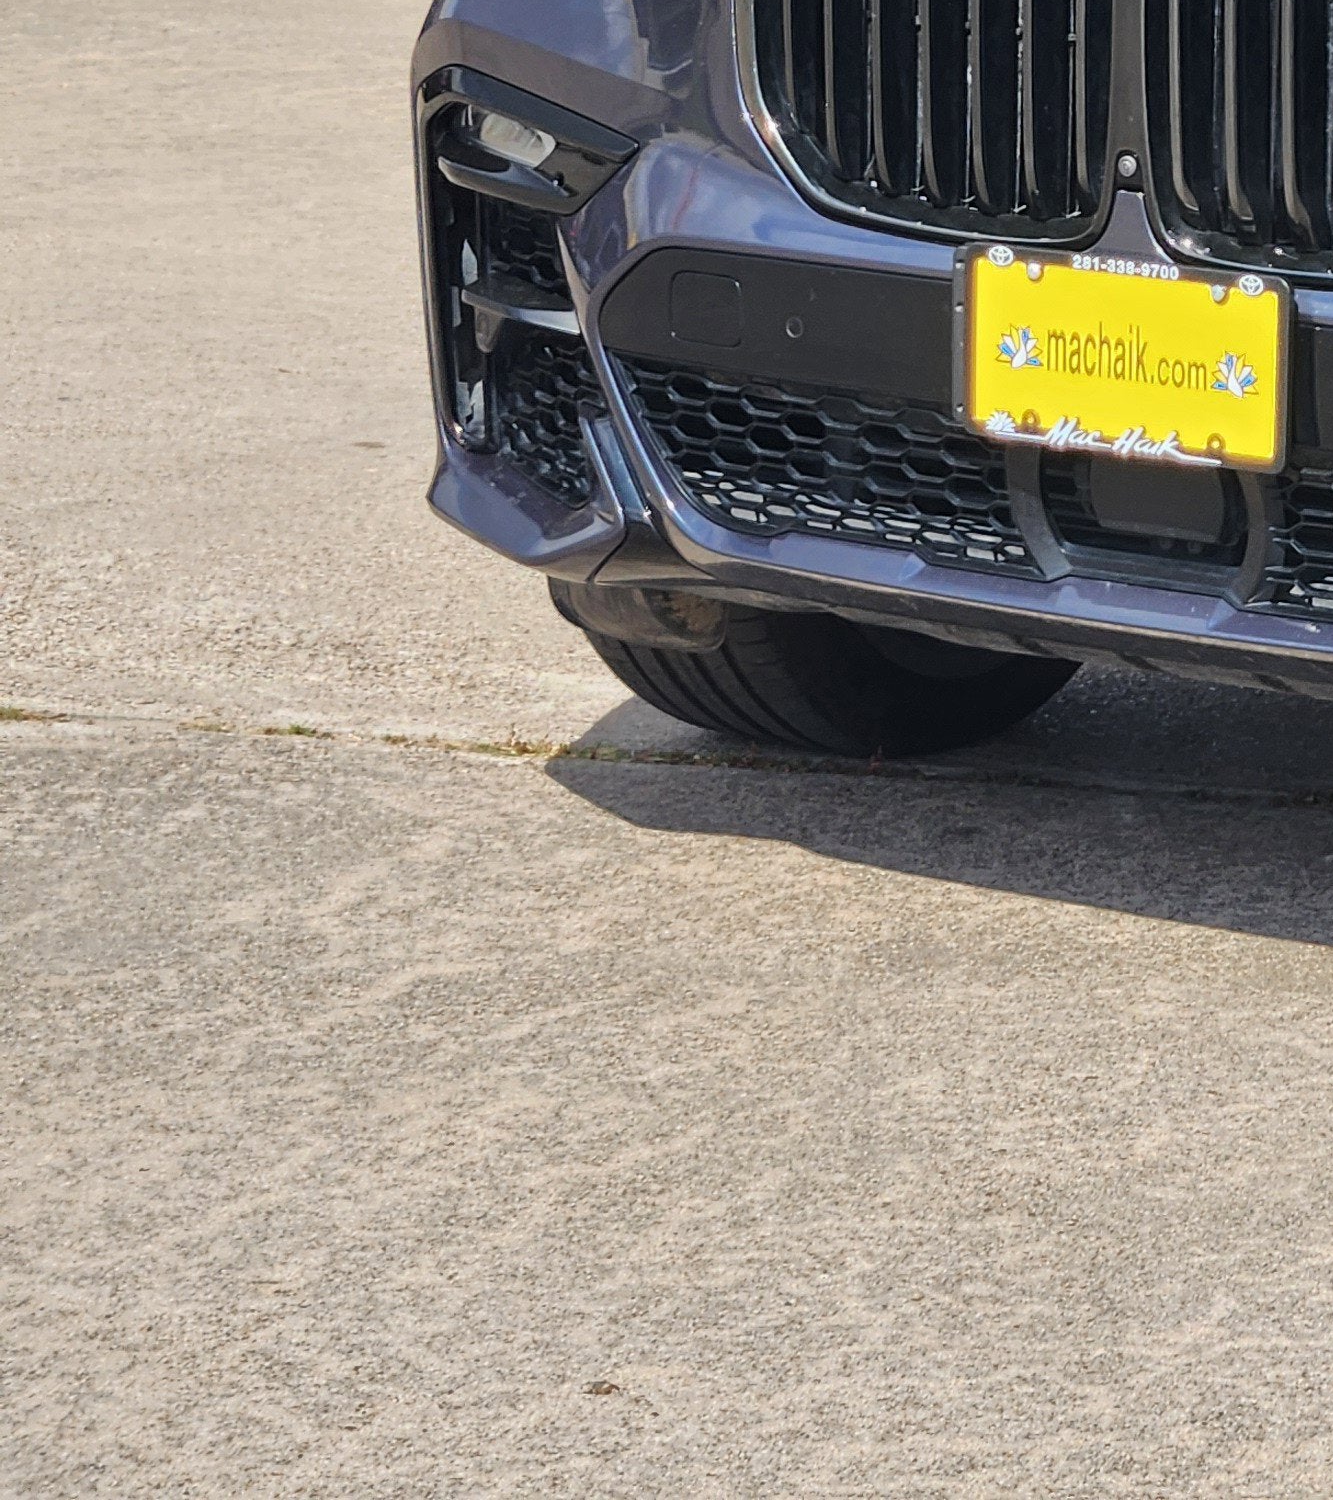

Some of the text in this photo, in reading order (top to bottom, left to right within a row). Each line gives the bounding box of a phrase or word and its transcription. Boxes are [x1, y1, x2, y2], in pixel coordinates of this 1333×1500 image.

[1046, 321, 1207, 392] machaik.com
[1044, 415, 1198, 460] Mac Haik
